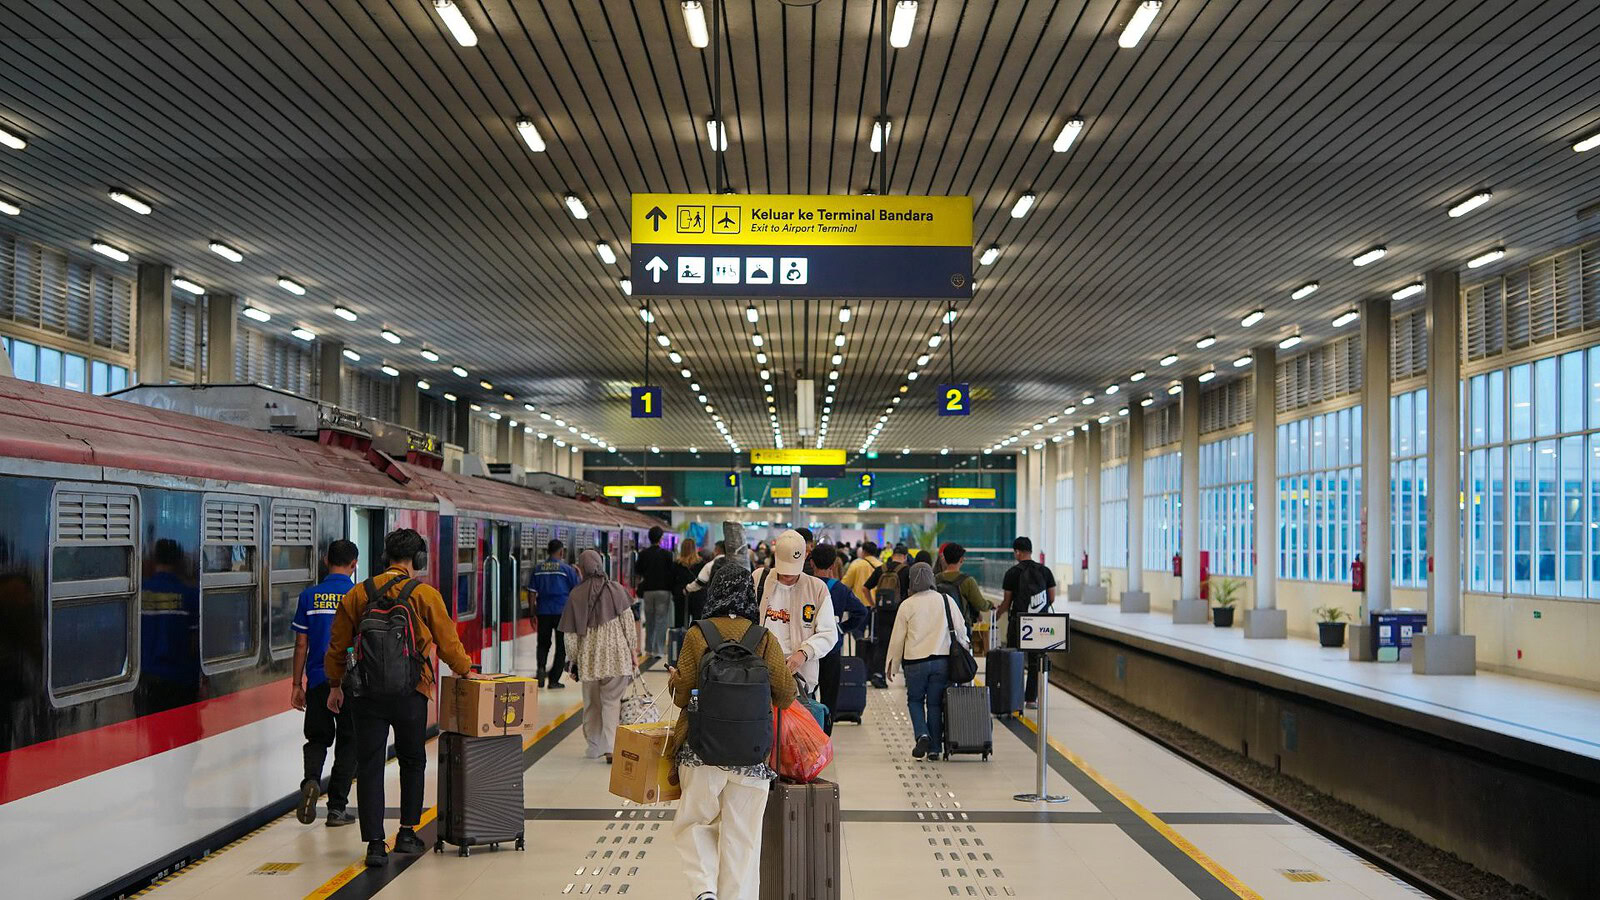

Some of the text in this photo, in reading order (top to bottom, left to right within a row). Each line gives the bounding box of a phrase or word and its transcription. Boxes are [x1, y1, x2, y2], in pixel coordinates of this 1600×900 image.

[751, 208, 934, 221] Keluar ke Terminal Bandara
[751, 223, 858, 234] Exit to Airport Terminal
[640, 392, 652, 413] 1
[946, 388, 963, 411] 2
[729, 474, 736, 486] 1
[862, 474, 871, 486] 2
[313, 601, 340, 609] SERV
[1021, 624, 1034, 641] 2
